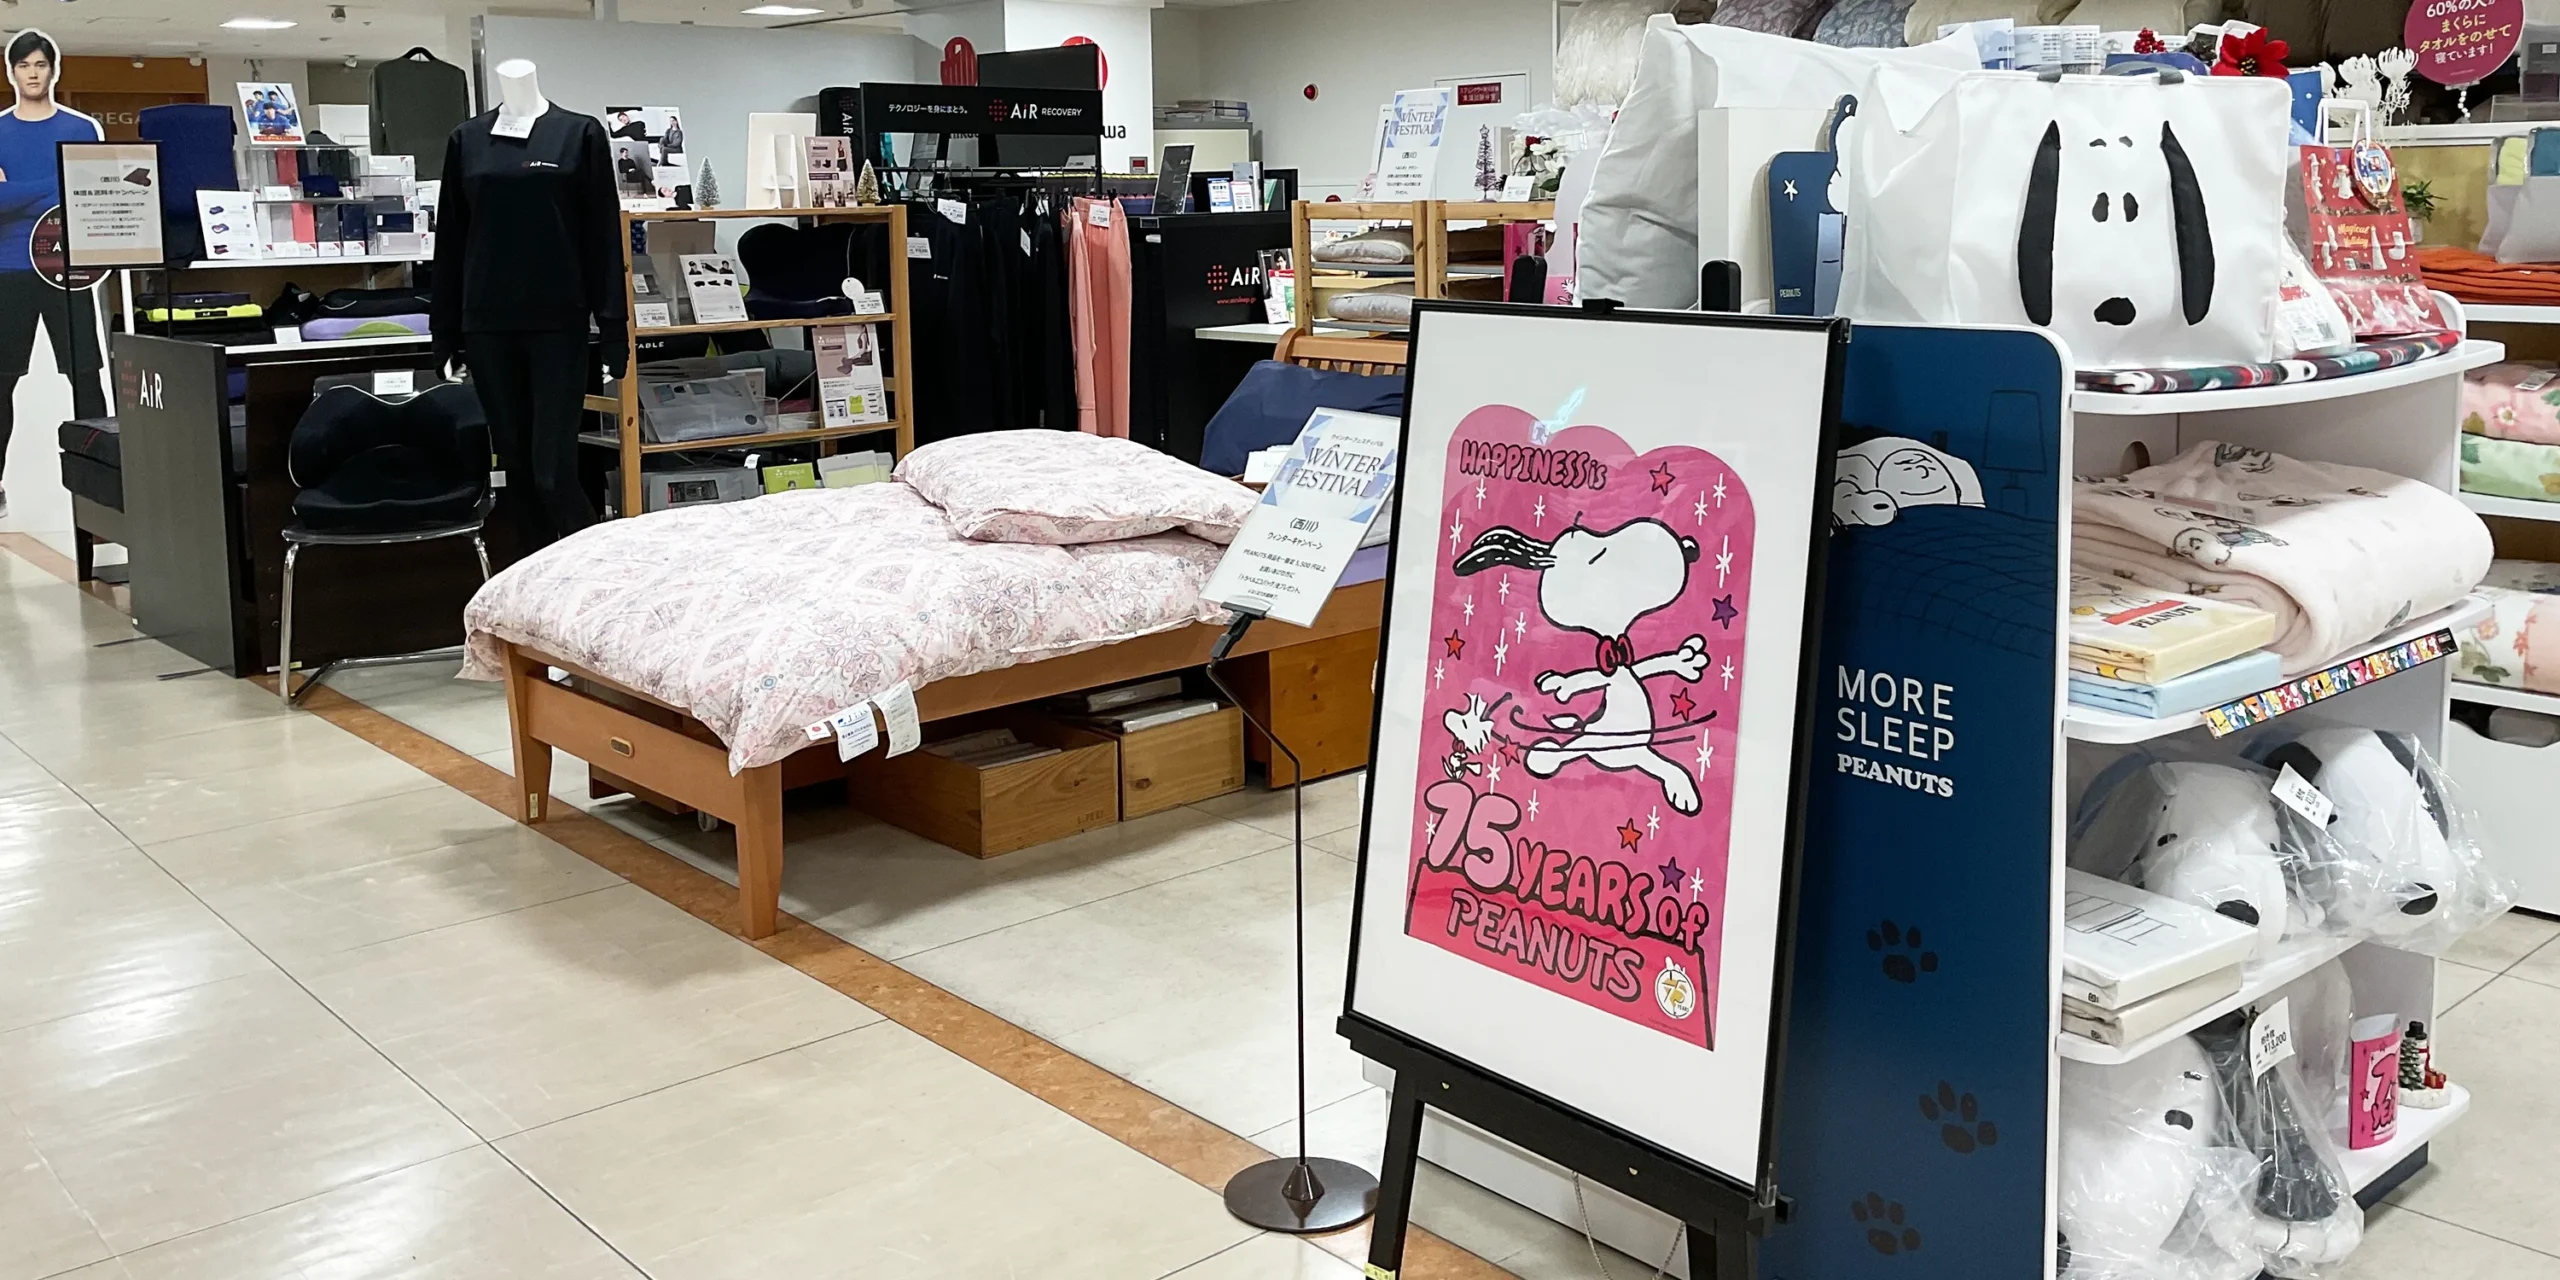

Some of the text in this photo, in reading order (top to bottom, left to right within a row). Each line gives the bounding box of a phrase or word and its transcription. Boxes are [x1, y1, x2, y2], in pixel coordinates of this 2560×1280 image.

[2419, 24, 2512, 53] タオルをのせて
[2441, 14, 2486, 33] まくらに
[1041, 108, 1083, 117] RECOVERY
[635, 341, 665, 349] ABLE
[1459, 440, 1608, 490] HAPPINESS is
[2129, 605, 2202, 628] PEANUTS
[1838, 665, 1954, 721] MORE
[1836, 707, 1955, 762] SLEEP
[1837, 753, 1954, 798] PEANUTS
[1424, 780, 1709, 956] 75 YEARS of
[1447, 890, 1644, 1003] PEANUTS
